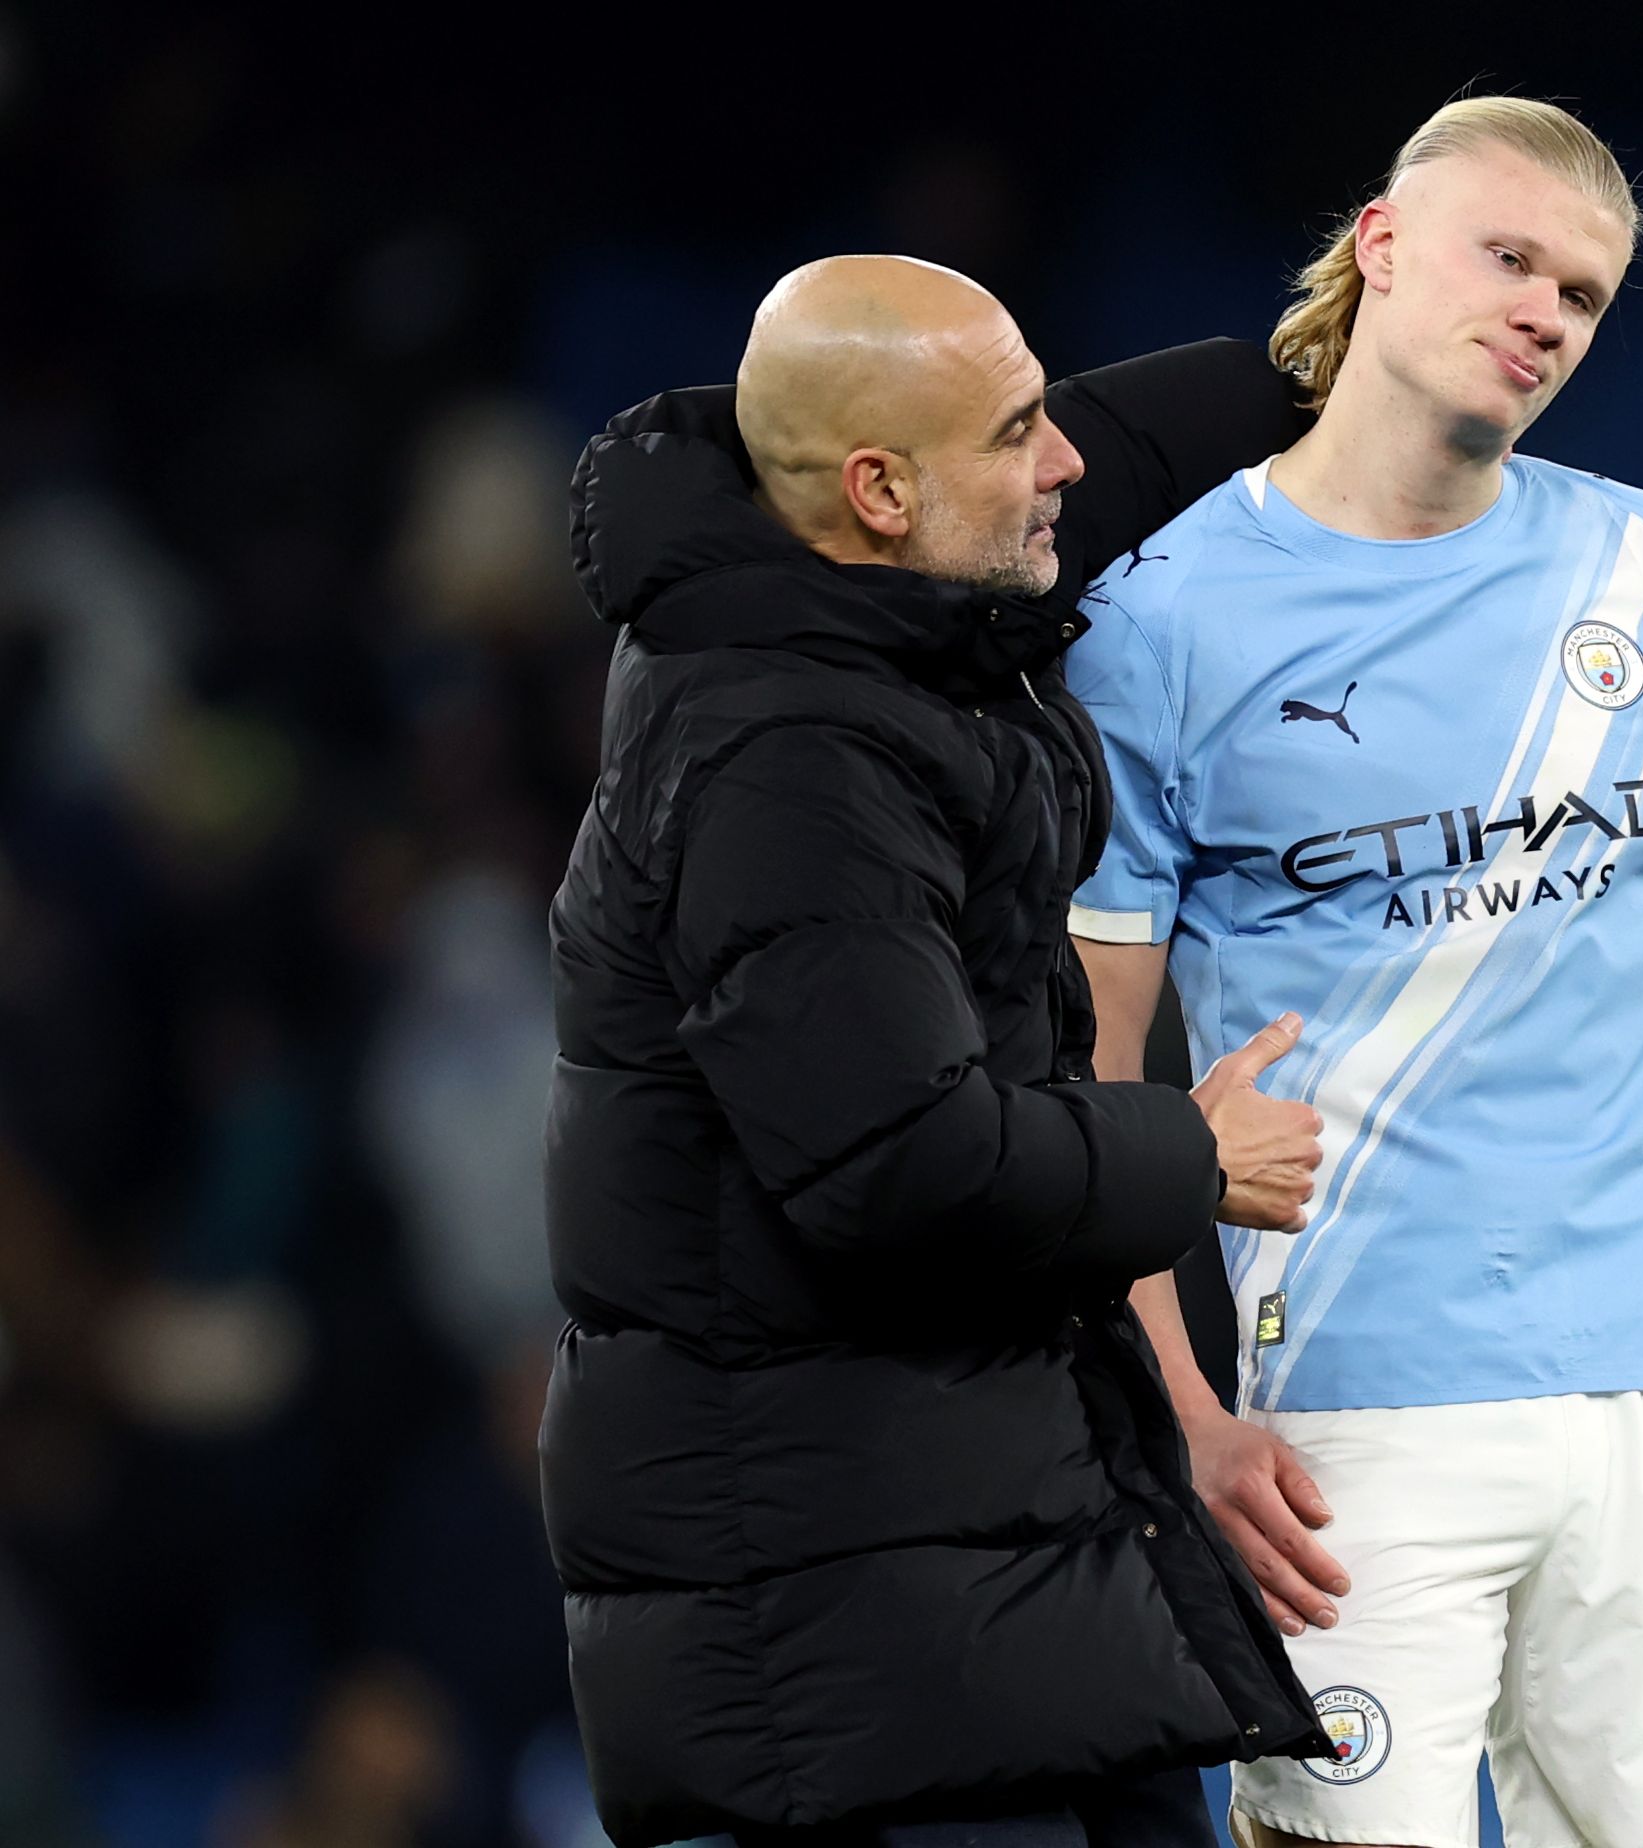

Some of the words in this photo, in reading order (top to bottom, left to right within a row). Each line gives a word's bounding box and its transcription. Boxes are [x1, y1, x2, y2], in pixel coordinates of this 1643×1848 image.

[1567, 628, 1630, 657] MANCHESTER
[1602, 694, 1626, 704] CITY
[1382, 863, 1616, 930] AIRWAYS
[1316, 1694, 1378, 1720] NCHESTER
[1333, 1768, 1360, 1777] CITY
